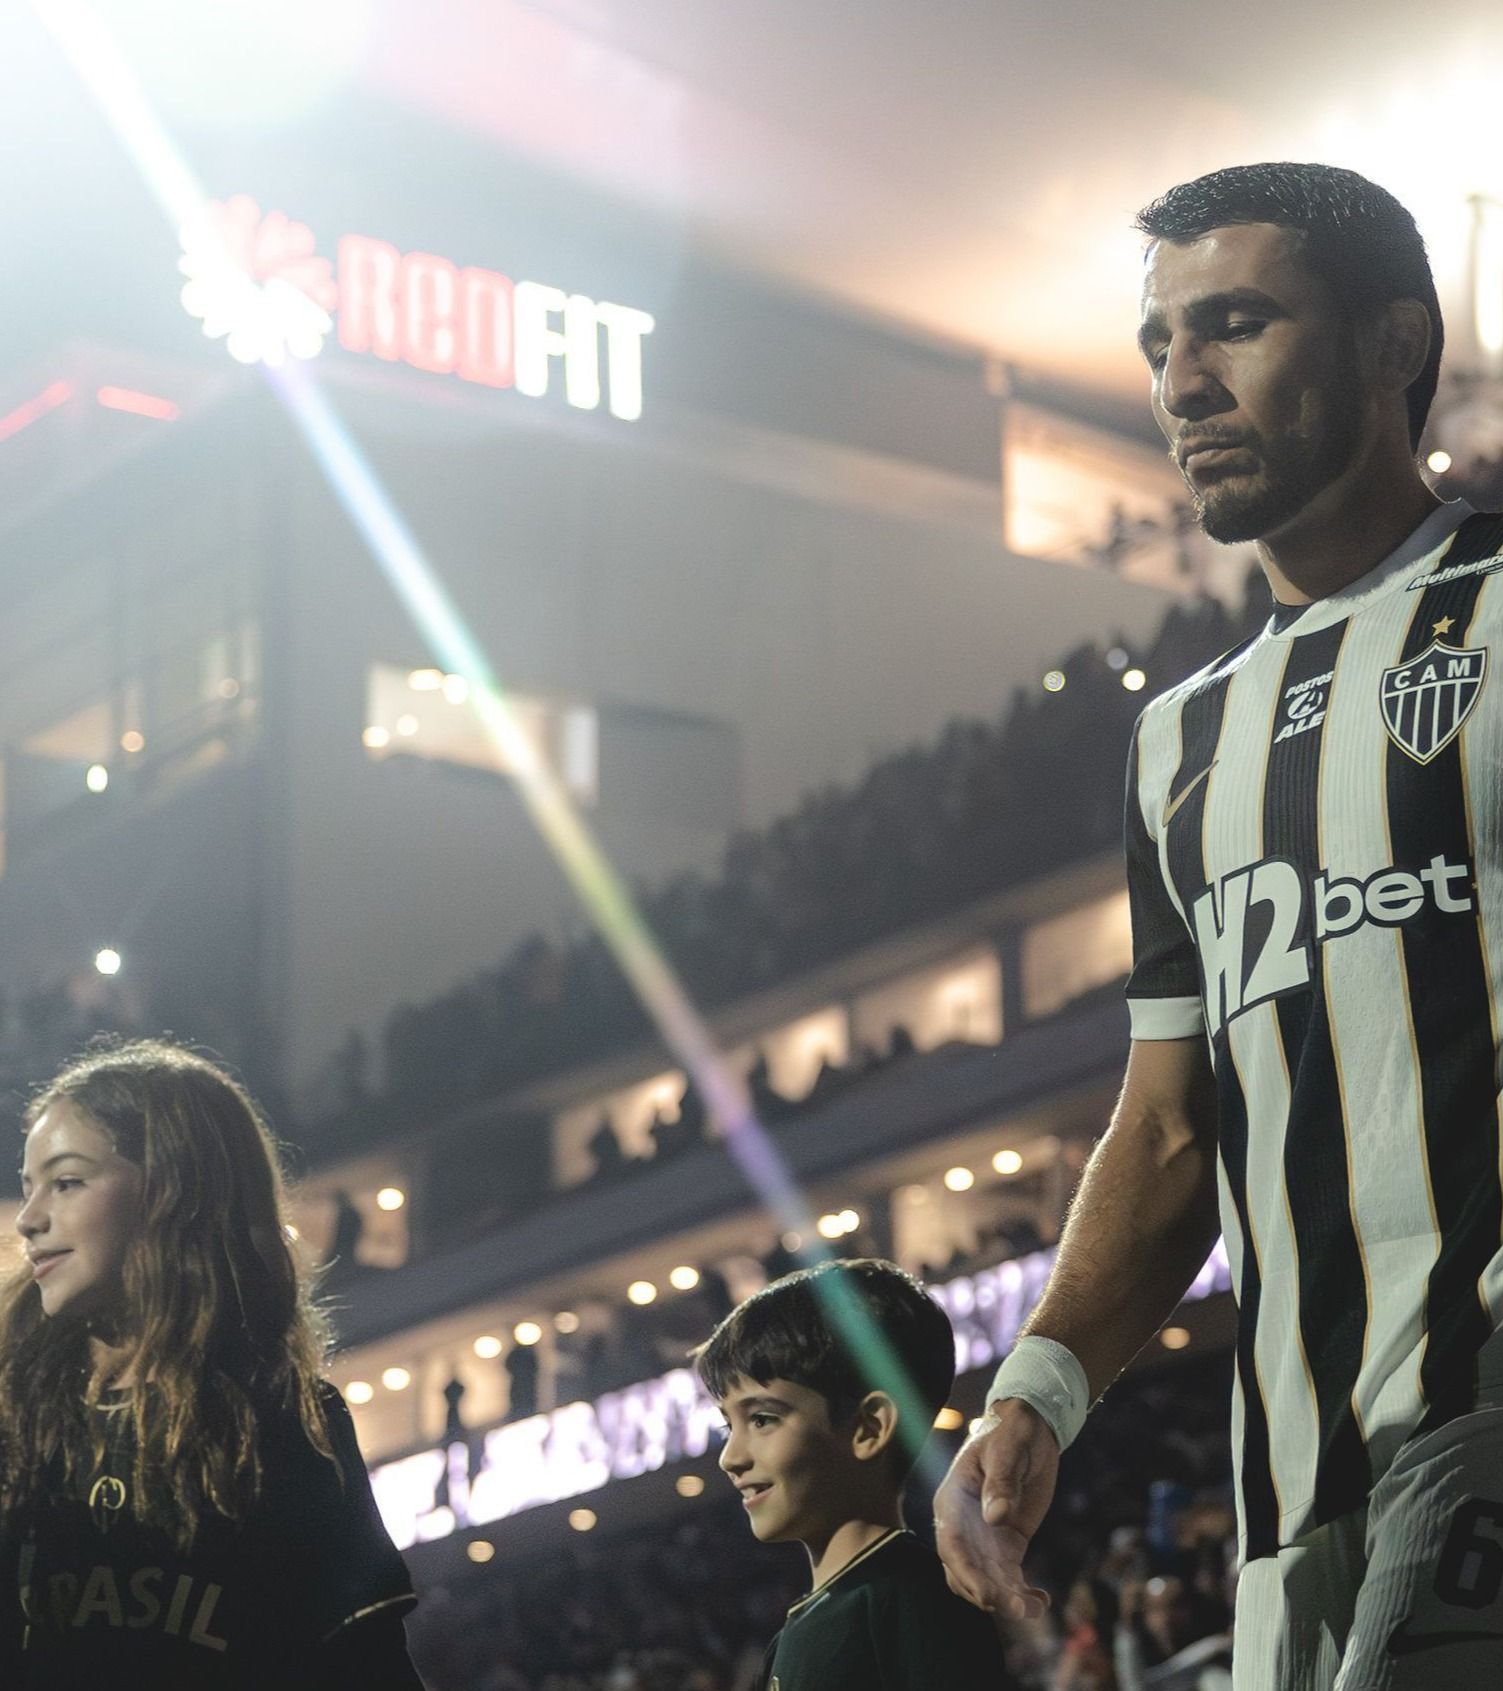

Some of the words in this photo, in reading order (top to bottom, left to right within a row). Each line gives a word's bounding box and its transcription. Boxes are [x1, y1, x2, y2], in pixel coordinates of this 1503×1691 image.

[1284, 670, 1335, 699] POSTOS
[1394, 657, 1471, 689] CAM
[1273, 710, 1327, 744] ALE
